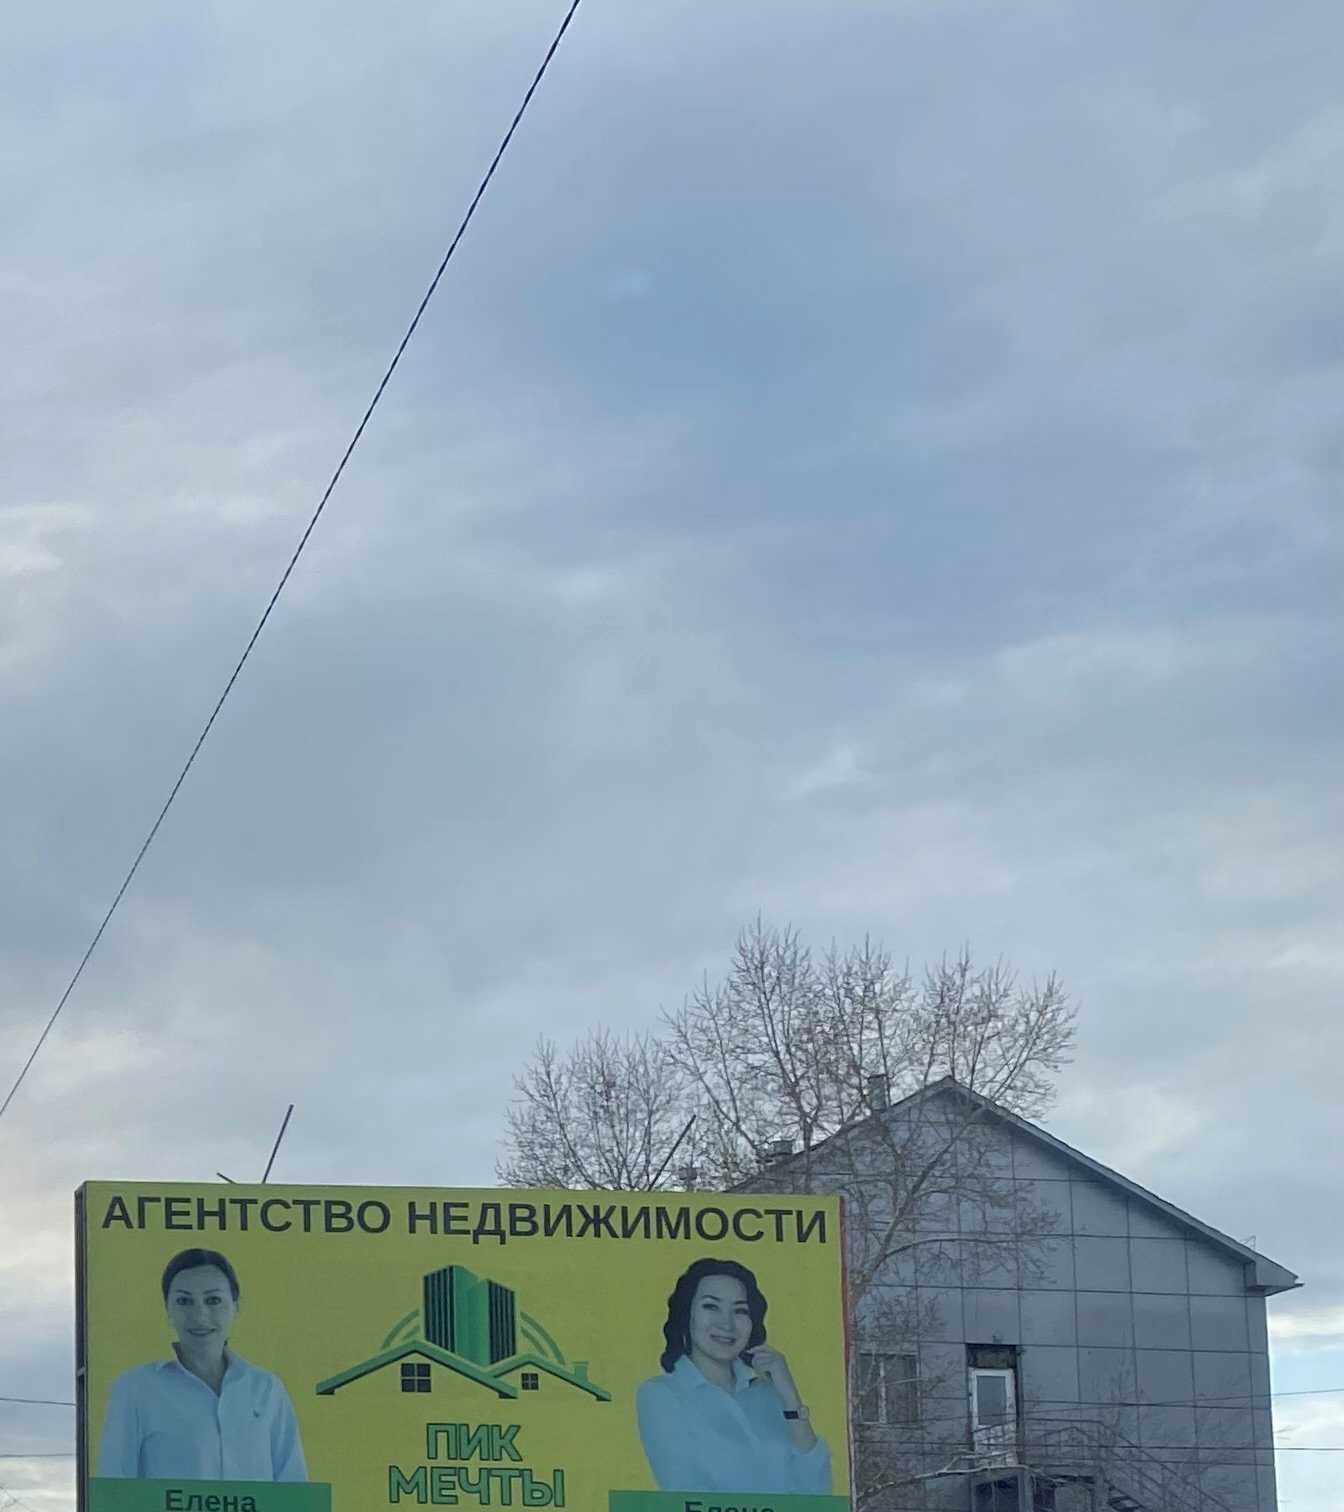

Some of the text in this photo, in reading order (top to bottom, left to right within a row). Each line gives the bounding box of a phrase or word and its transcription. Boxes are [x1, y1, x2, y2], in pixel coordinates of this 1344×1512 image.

[102, 1196, 827, 1245] АГЕНТСТВО НЕДВИЖИМОСТИ
[426, 1423, 523, 1462] ПИК
[165, 1489, 257, 1512] Елена
[389, 1465, 565, 1507] МЕЧТЫ
